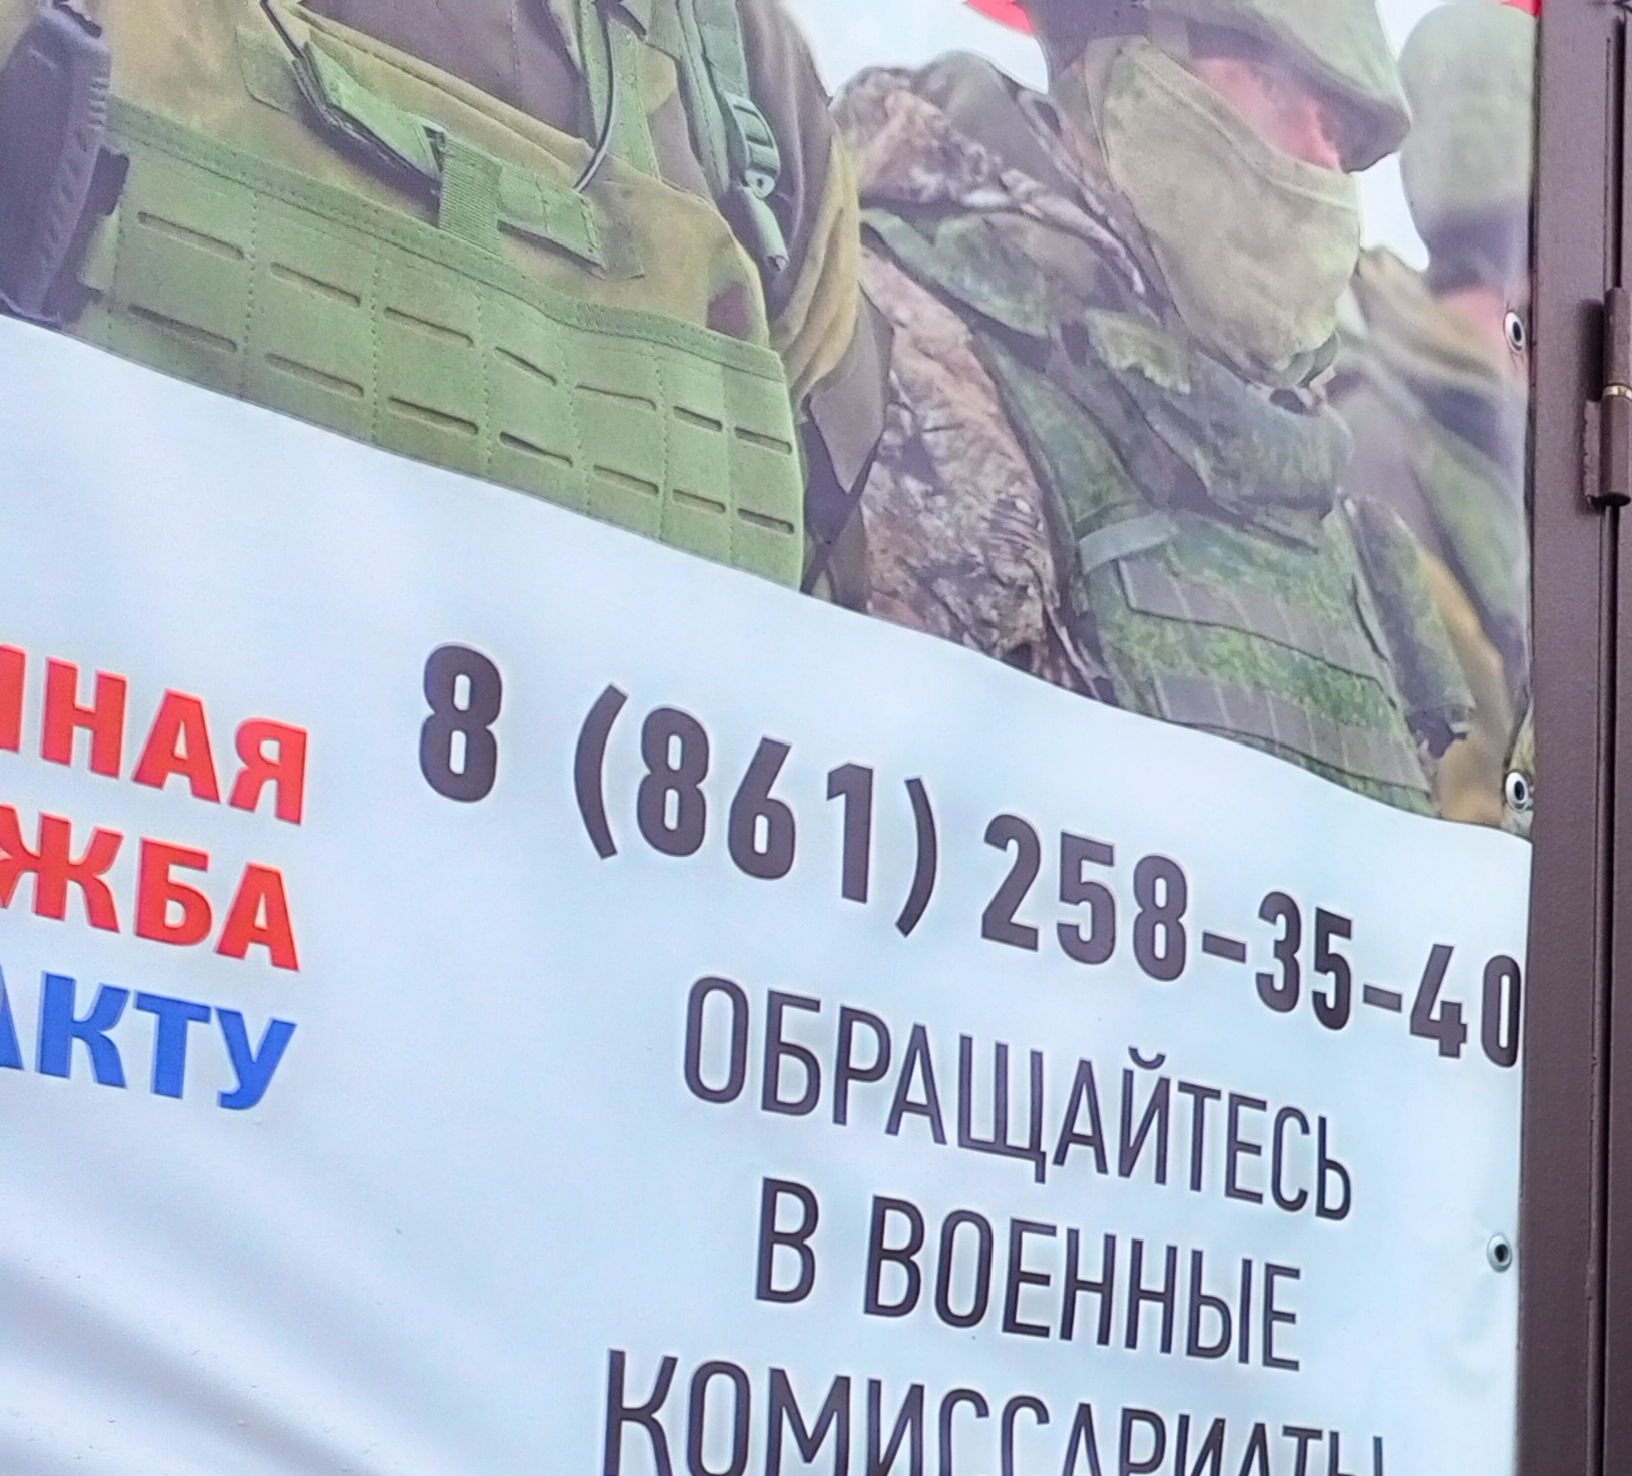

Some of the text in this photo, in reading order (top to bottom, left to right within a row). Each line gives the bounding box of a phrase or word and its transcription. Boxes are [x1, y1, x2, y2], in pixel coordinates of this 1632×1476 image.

[418, 644, 1522, 1069] 8 (861) 258-35-40
[683, 976, 1352, 1221] ОБРАЩАЙТЕСЬ
[755, 1176, 1301, 1372] В ВОЕННЫЕ
